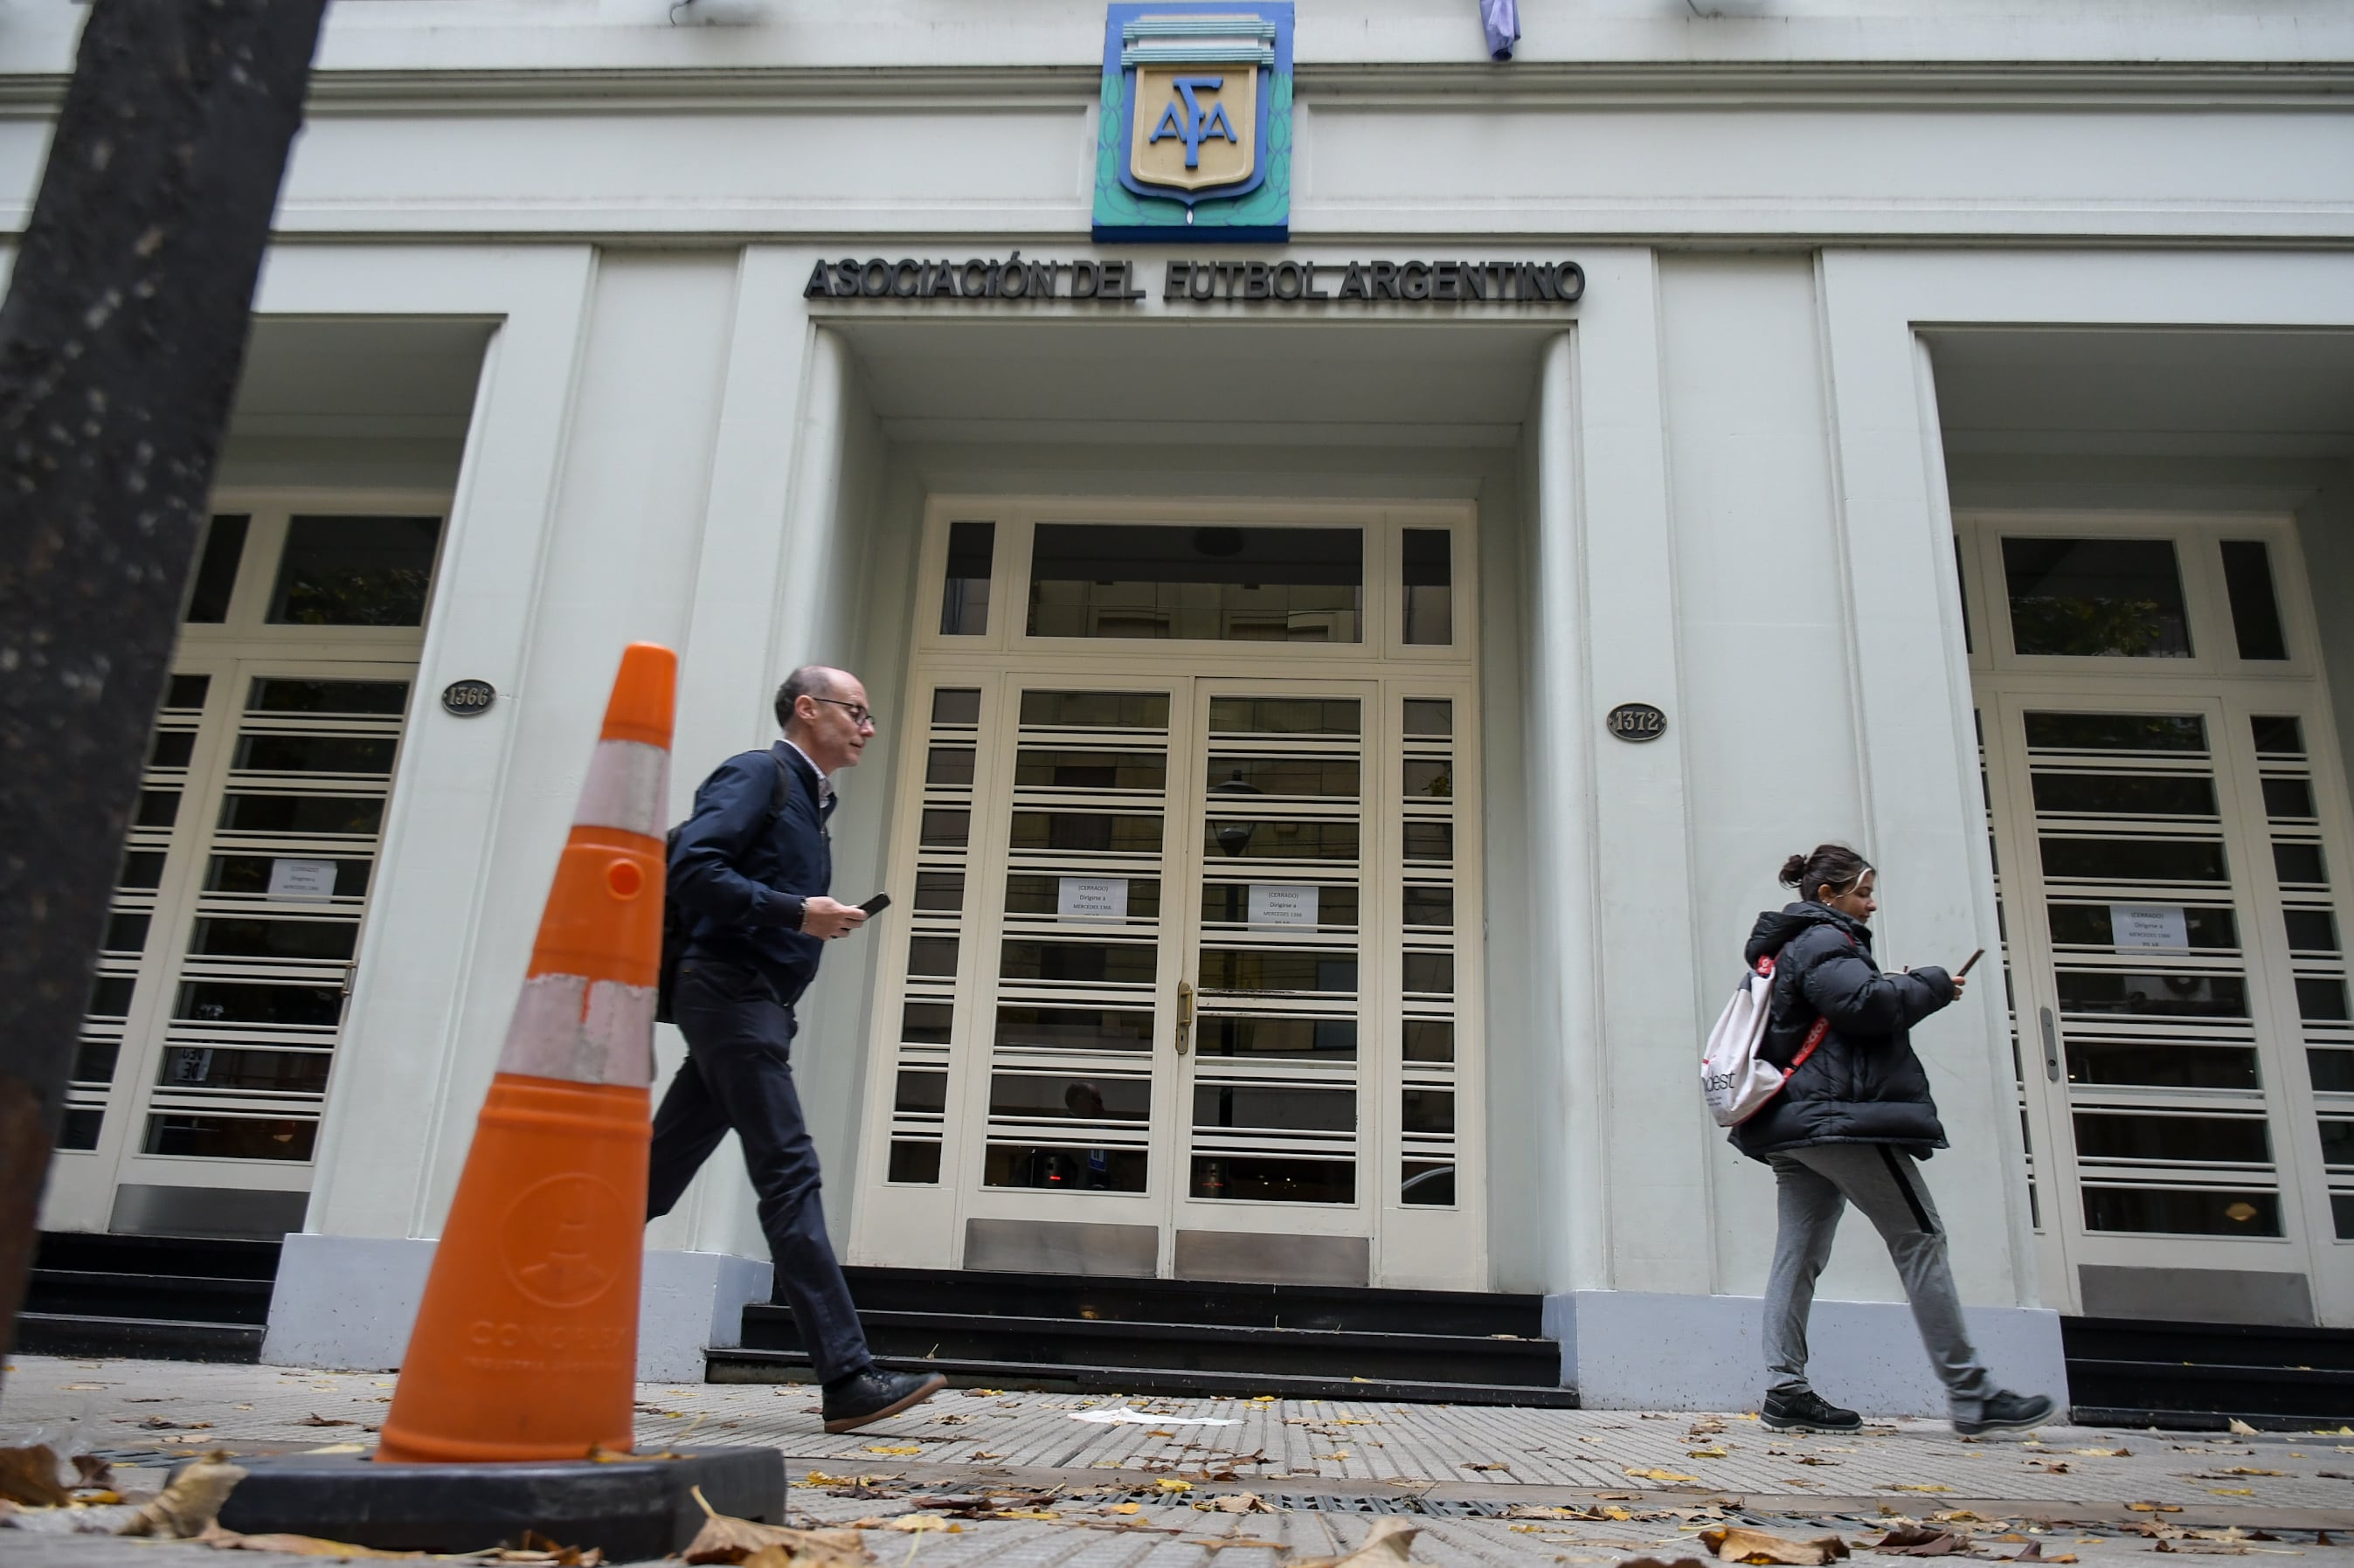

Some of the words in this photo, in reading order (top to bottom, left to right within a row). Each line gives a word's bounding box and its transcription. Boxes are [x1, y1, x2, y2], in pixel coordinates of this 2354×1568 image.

[803, 251, 1057, 299] ASOCIACIÓN
[1070, 259, 1146, 300] DEL
[1163, 260, 1328, 301] FUTBOL
[1338, 260, 1586, 301] ARGENTINO
[449, 687, 489, 706] 1366
[1616, 711, 1658, 731] 1372
